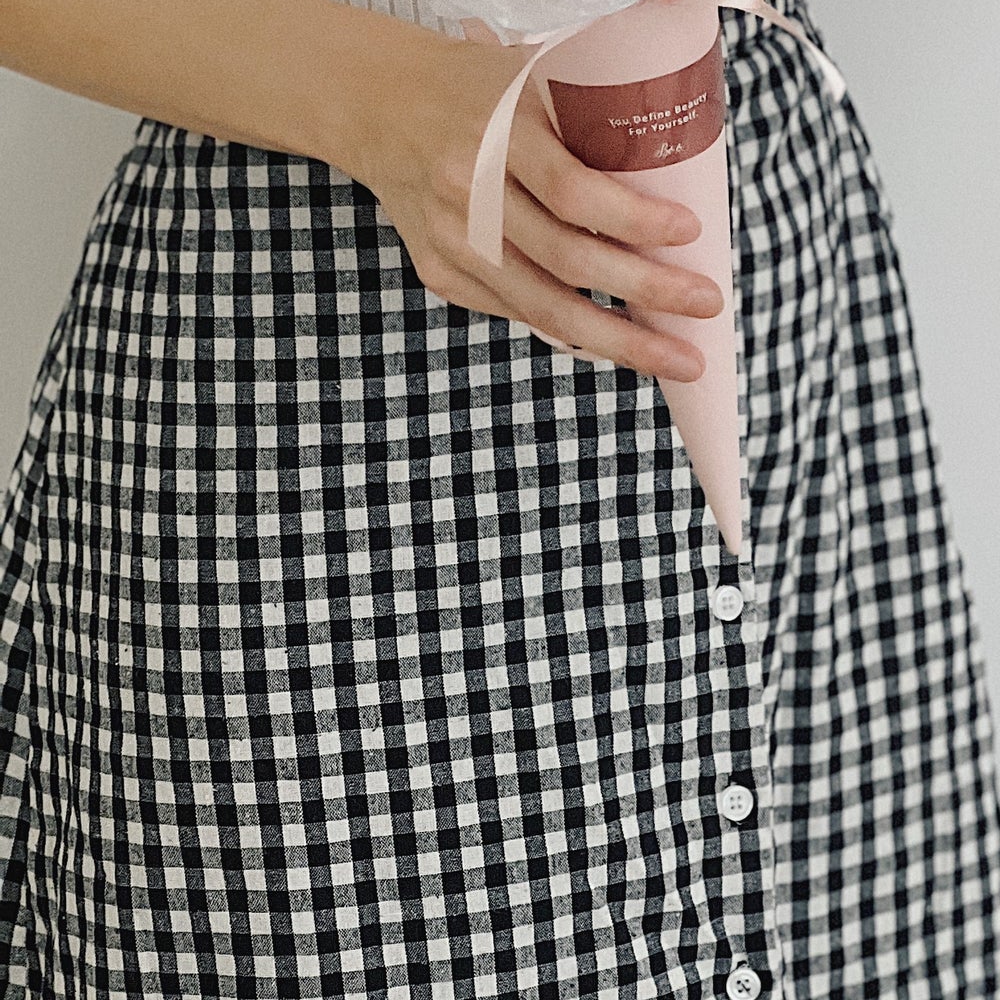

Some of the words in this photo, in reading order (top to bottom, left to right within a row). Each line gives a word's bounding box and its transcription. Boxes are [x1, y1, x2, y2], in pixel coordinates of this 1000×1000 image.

[629, 127, 648, 137] For
[651, 110, 700, 132] Yourself.
[633, 110, 672, 125] Define
[674, 92, 708, 114] Beauty
